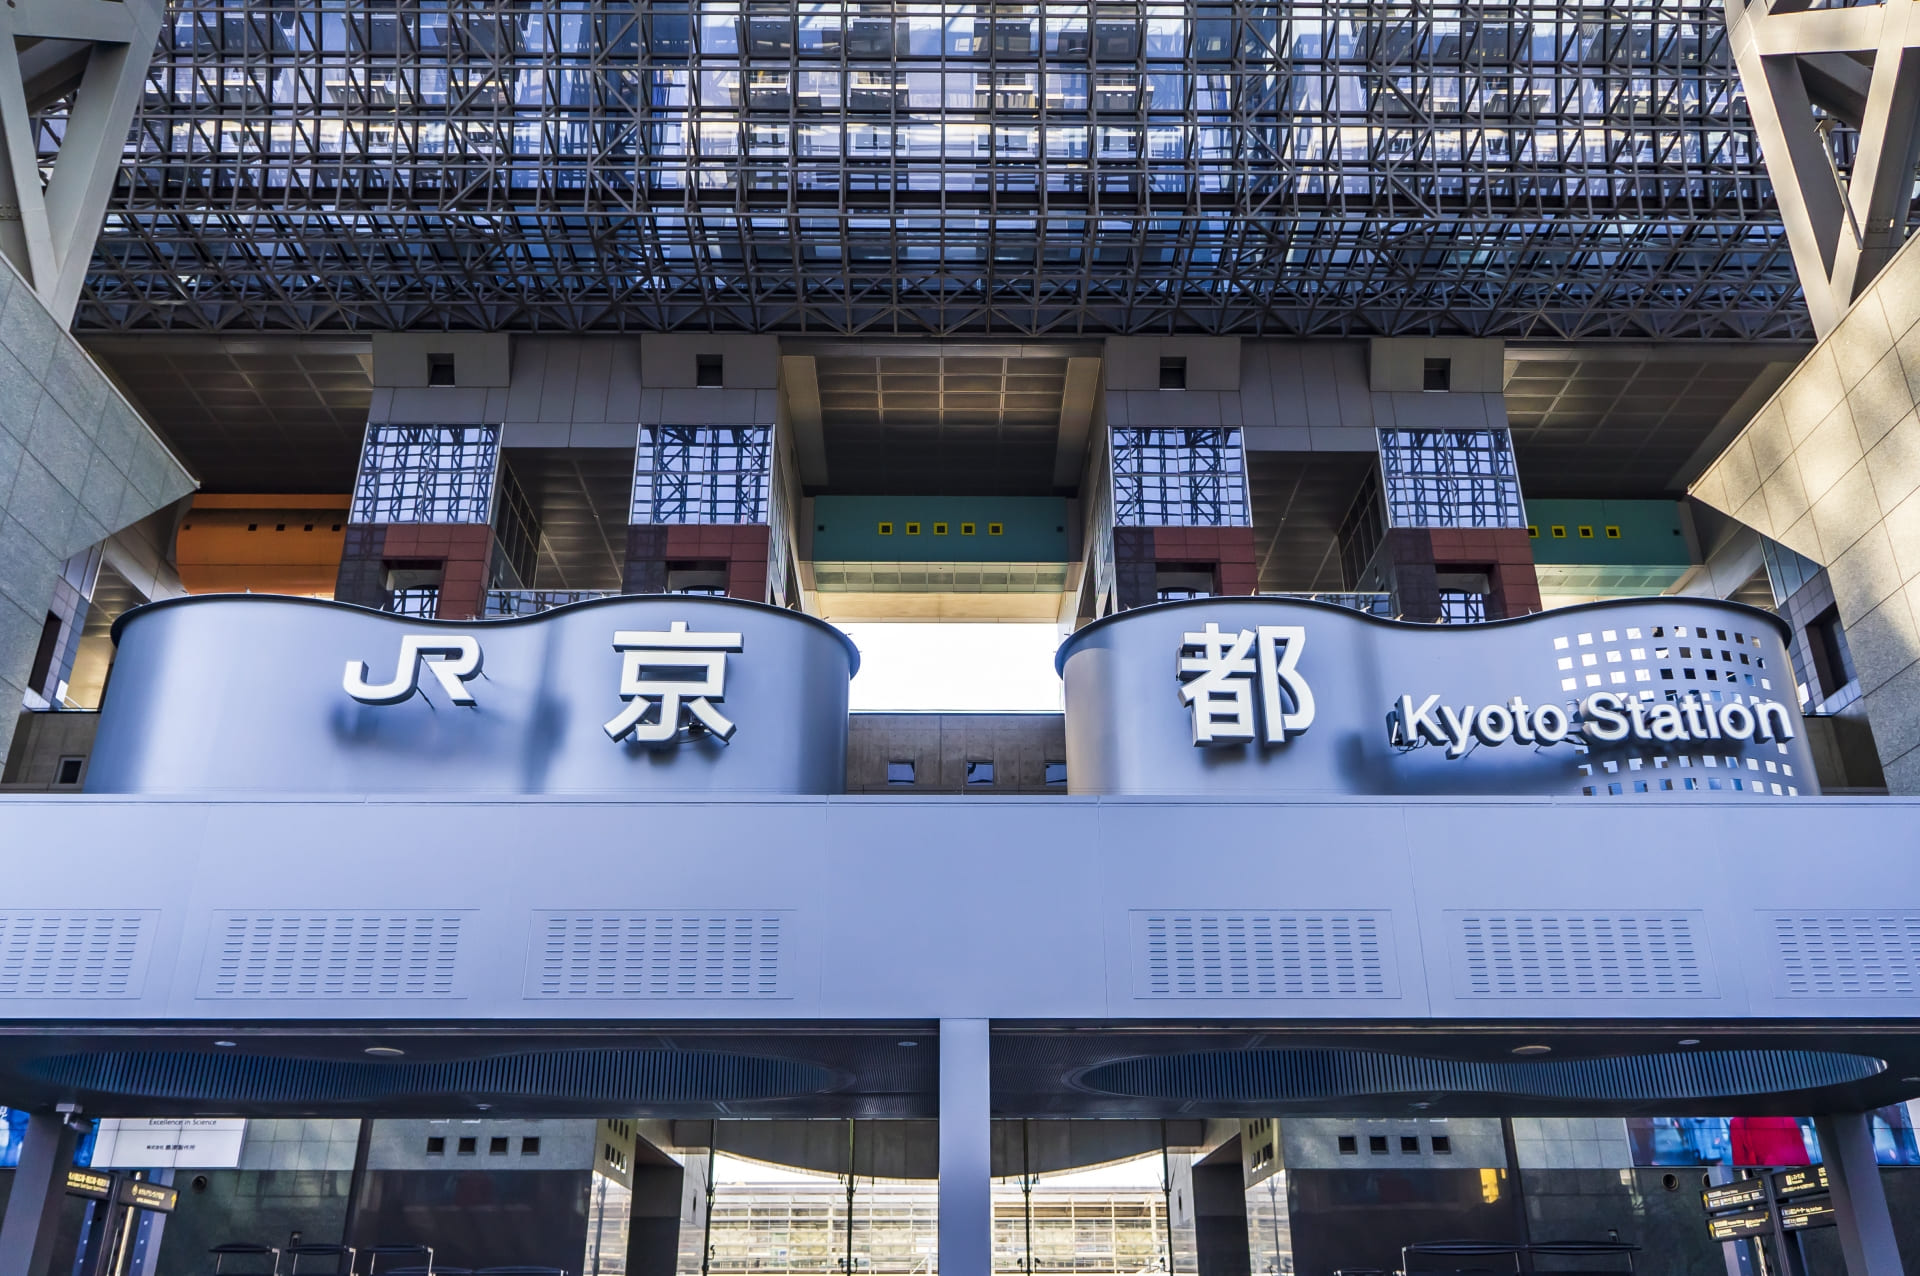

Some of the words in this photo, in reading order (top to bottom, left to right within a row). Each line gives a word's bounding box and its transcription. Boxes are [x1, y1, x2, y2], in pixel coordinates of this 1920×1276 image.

[343, 635, 483, 706] JR
[603, 621, 744, 743] 京
[1177, 622, 1316, 747] 都
[1397, 693, 1569, 760] Kyoto
[1580, 691, 1795, 744] Station
